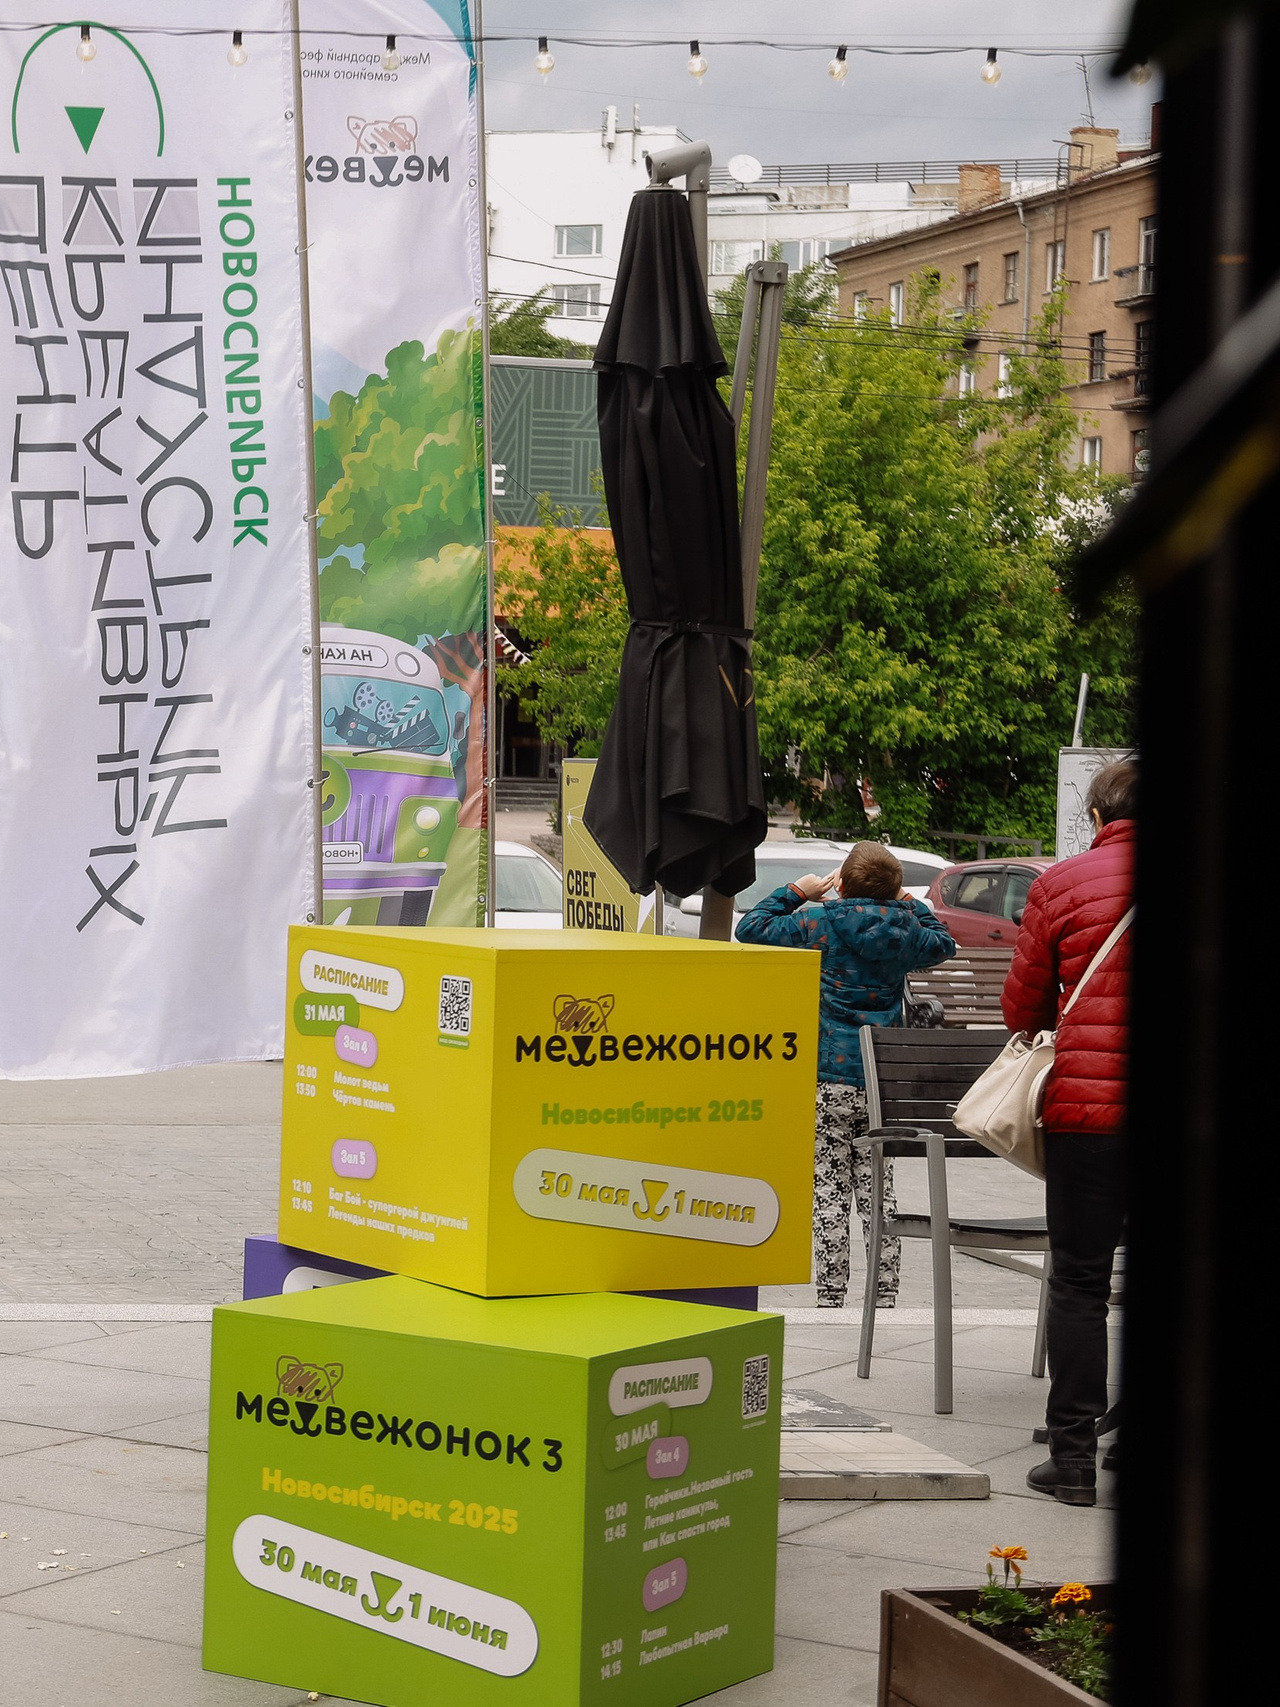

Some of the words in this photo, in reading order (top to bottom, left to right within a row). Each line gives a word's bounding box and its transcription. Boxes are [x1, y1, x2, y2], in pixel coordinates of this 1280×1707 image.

[566, 868, 596, 898] СВЕТ
[566, 898, 624, 932] ПОБЕДЫ
[314, 964, 389, 996] РАСПИСАНИЕ
[304, 1004, 316, 1020] 31
[318, 1004, 346, 1022] МАЯ
[344, 1034, 360, 1052] Зал
[361, 1040, 368, 1054] 4
[782, 1032, 798, 1061] 3
[296, 1064, 318, 1080] 12:00
[334, 1070, 362, 1088] Молот
[362, 1080, 390, 1093] ведьм
[296, 1082, 316, 1098] 13:50
[332, 1088, 362, 1107] Чёртов
[364, 1098, 396, 1113] камень
[542, 1100, 702, 1130] Новосибирск
[708, 1099, 764, 1122] 2025
[340, 1149, 358, 1165] Зал
[360, 1151, 366, 1166] 5
[292, 1178, 312, 1194] 12:10
[538, 1170, 573, 1198] 30
[578, 1182, 630, 1207] мая
[674, 1189, 686, 1214] 1
[689, 1198, 756, 1224] июня
[292, 1197, 313, 1213] 13:45
[329, 1187, 344, 1201] Баг
[345, 1190, 361, 1206] Бой
[368, 1200, 419, 1220] супергерой
[420, 1212, 468, 1230] джунглей
[328, 1206, 365, 1227] Легенды
[367, 1218, 395, 1233] наших
[397, 1224, 435, 1242] предков
[624, 1373, 699, 1399] РАСПИСАНИЕ
[615, 1432, 628, 1452] 30
[631, 1420, 658, 1446] МАЯ
[542, 1438, 563, 1472] 3
[656, 1449, 672, 1464] Зал
[673, 1447, 680, 1462] 4
[732, 1468, 754, 1483] гость
[262, 1467, 442, 1522] Новосибирск
[448, 1499, 518, 1535] 2025
[660, 1531, 676, 1547] Как
[707, 1515, 731, 1533] город
[259, 1538, 296, 1573] 30
[300, 1561, 358, 1597] мая
[409, 1592, 422, 1620] 1
[428, 1605, 508, 1651] июня
[652, 1579, 669, 1595] Зал
[671, 1570, 677, 1587] 5
